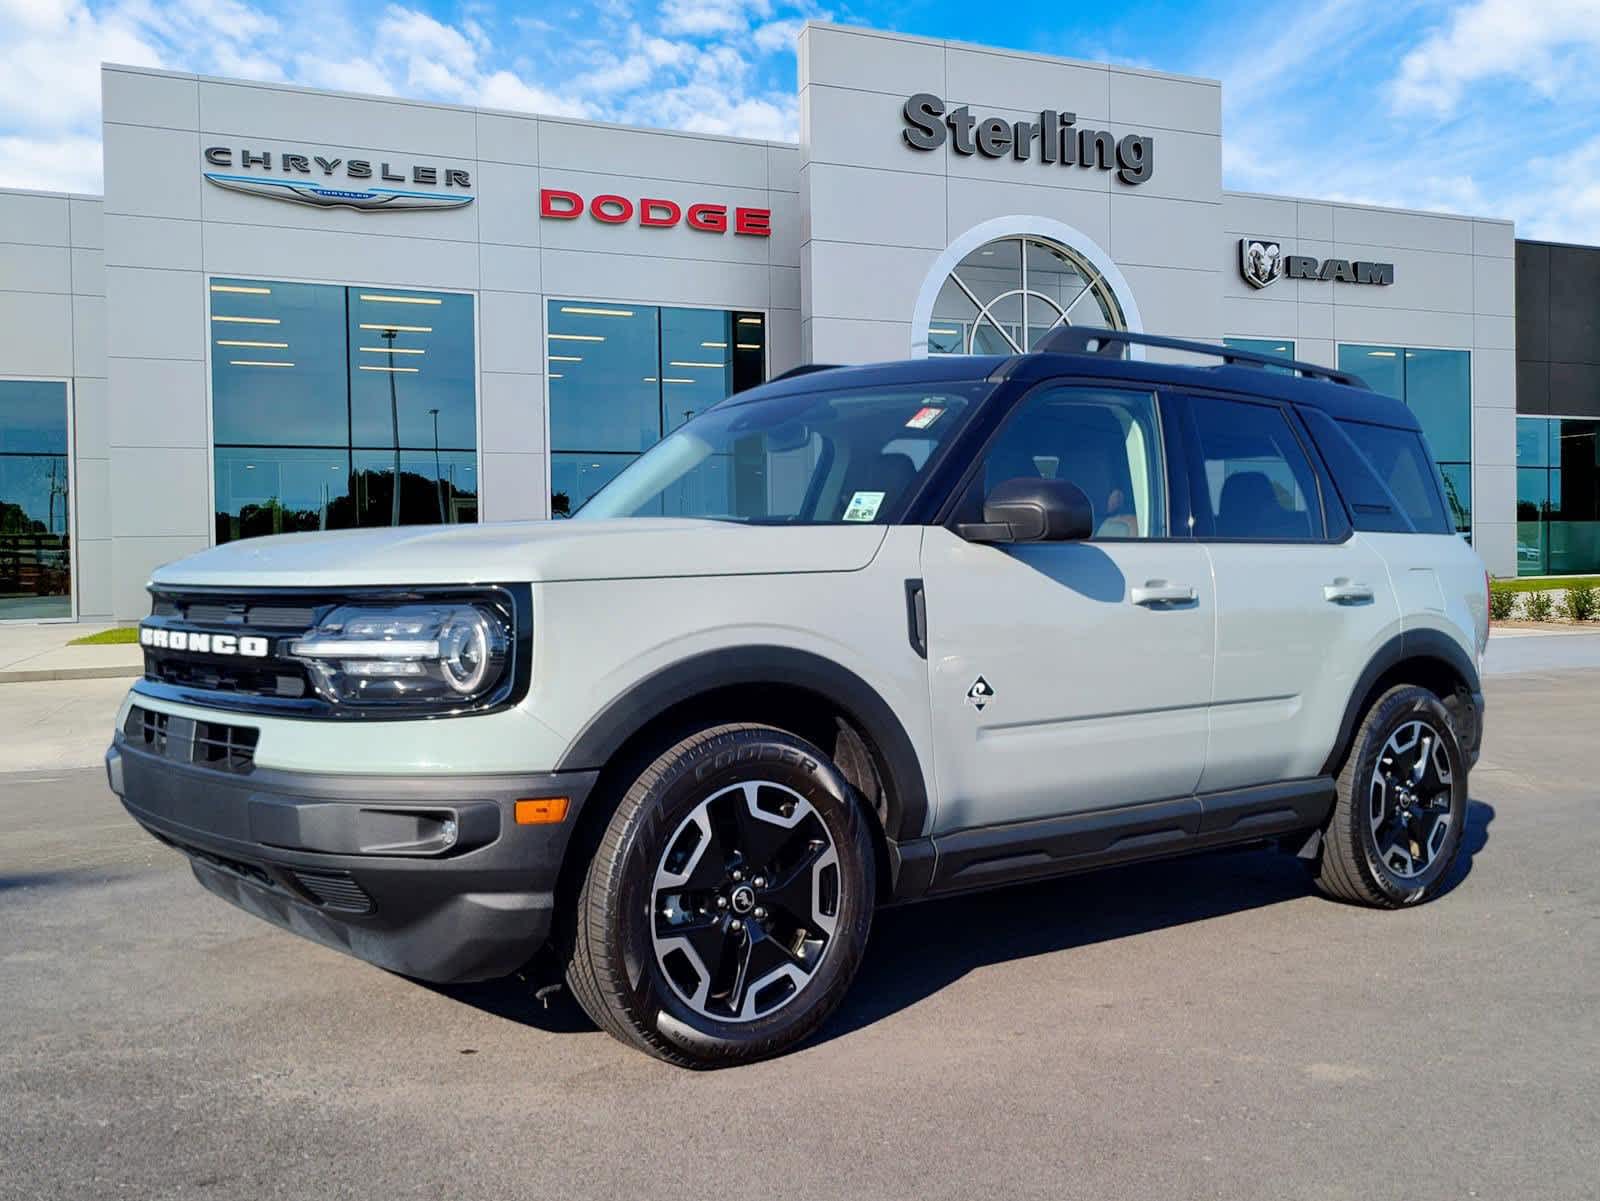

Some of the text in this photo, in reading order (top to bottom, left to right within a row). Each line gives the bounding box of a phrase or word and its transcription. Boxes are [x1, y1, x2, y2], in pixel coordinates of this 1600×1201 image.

[902, 93, 1153, 184] Sterling
[204, 147, 471, 187] CHRYSLER
[540, 188, 771, 236] DODGE
[1285, 255, 1394, 285] RAM
[141, 627, 268, 657] BRONCO
